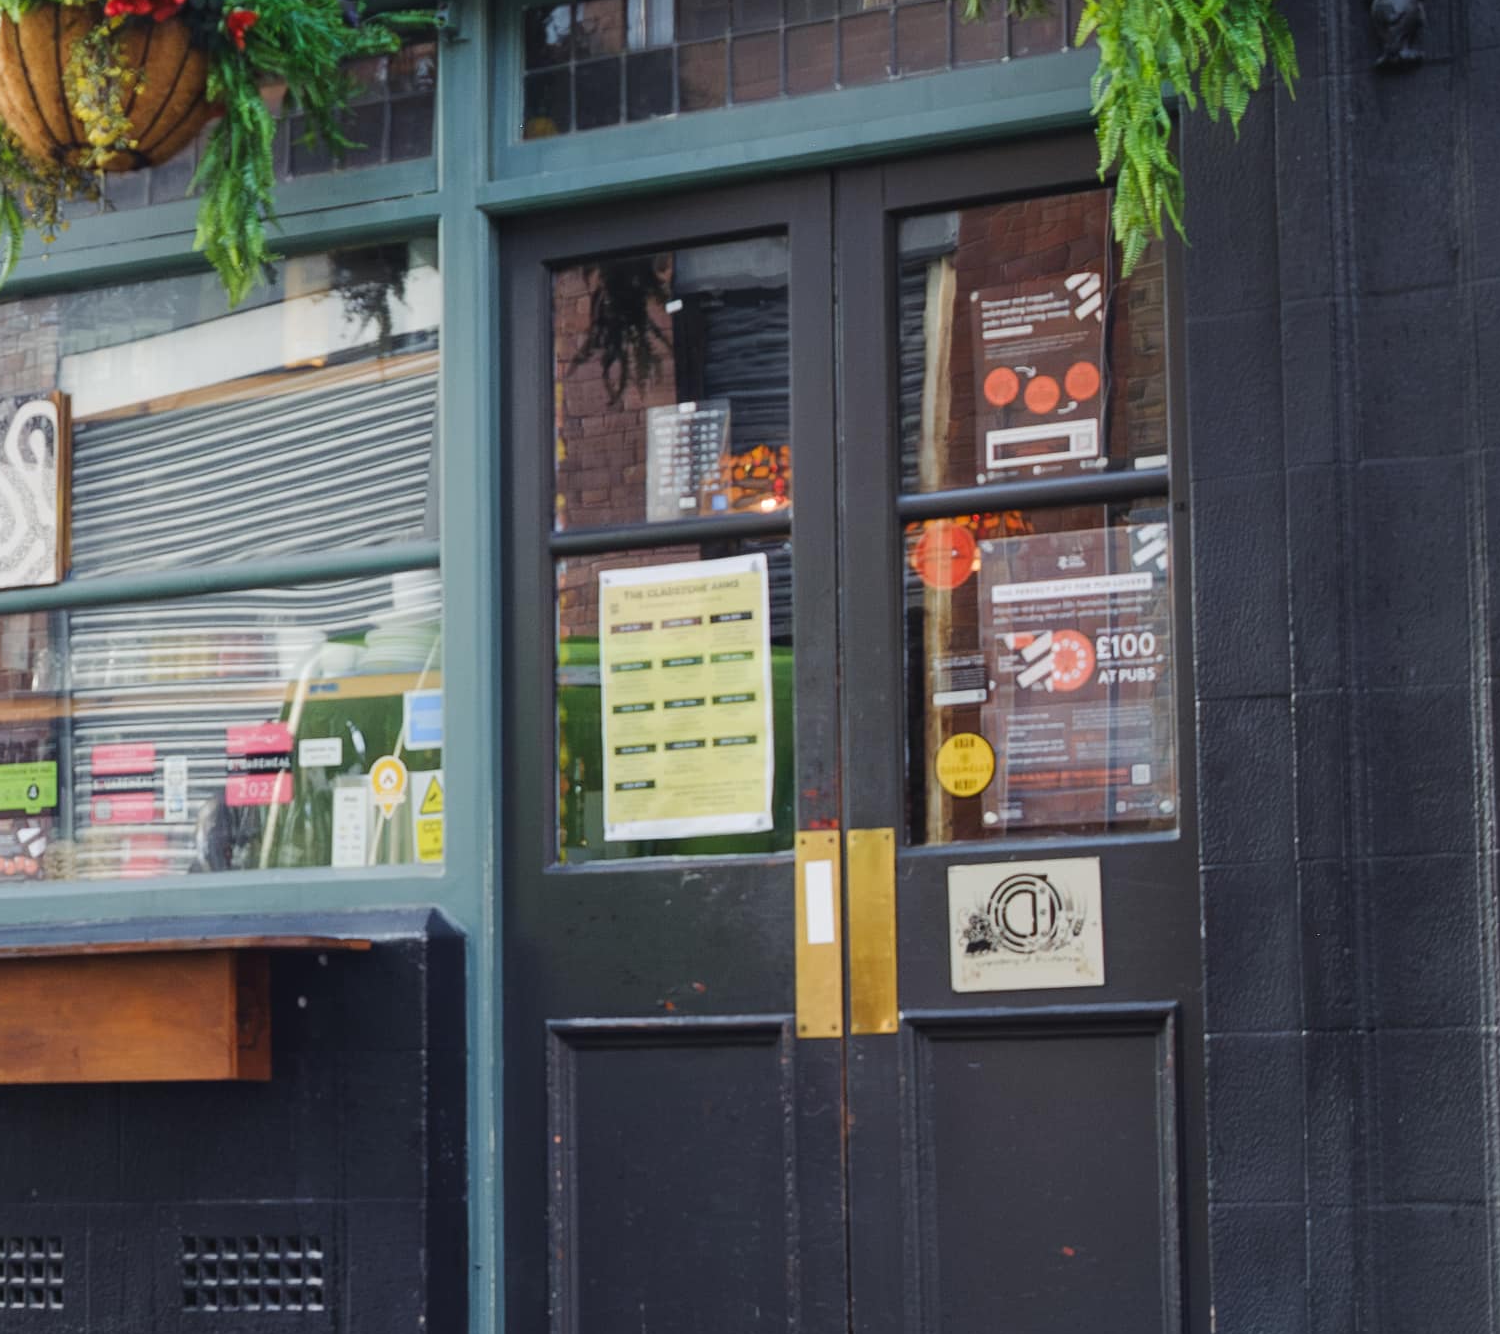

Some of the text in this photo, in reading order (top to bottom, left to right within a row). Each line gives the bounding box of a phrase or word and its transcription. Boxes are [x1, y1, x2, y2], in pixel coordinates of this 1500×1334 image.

[1095, 632, 1156, 660] £100
[1097, 667, 1156, 684] AT PUBS
